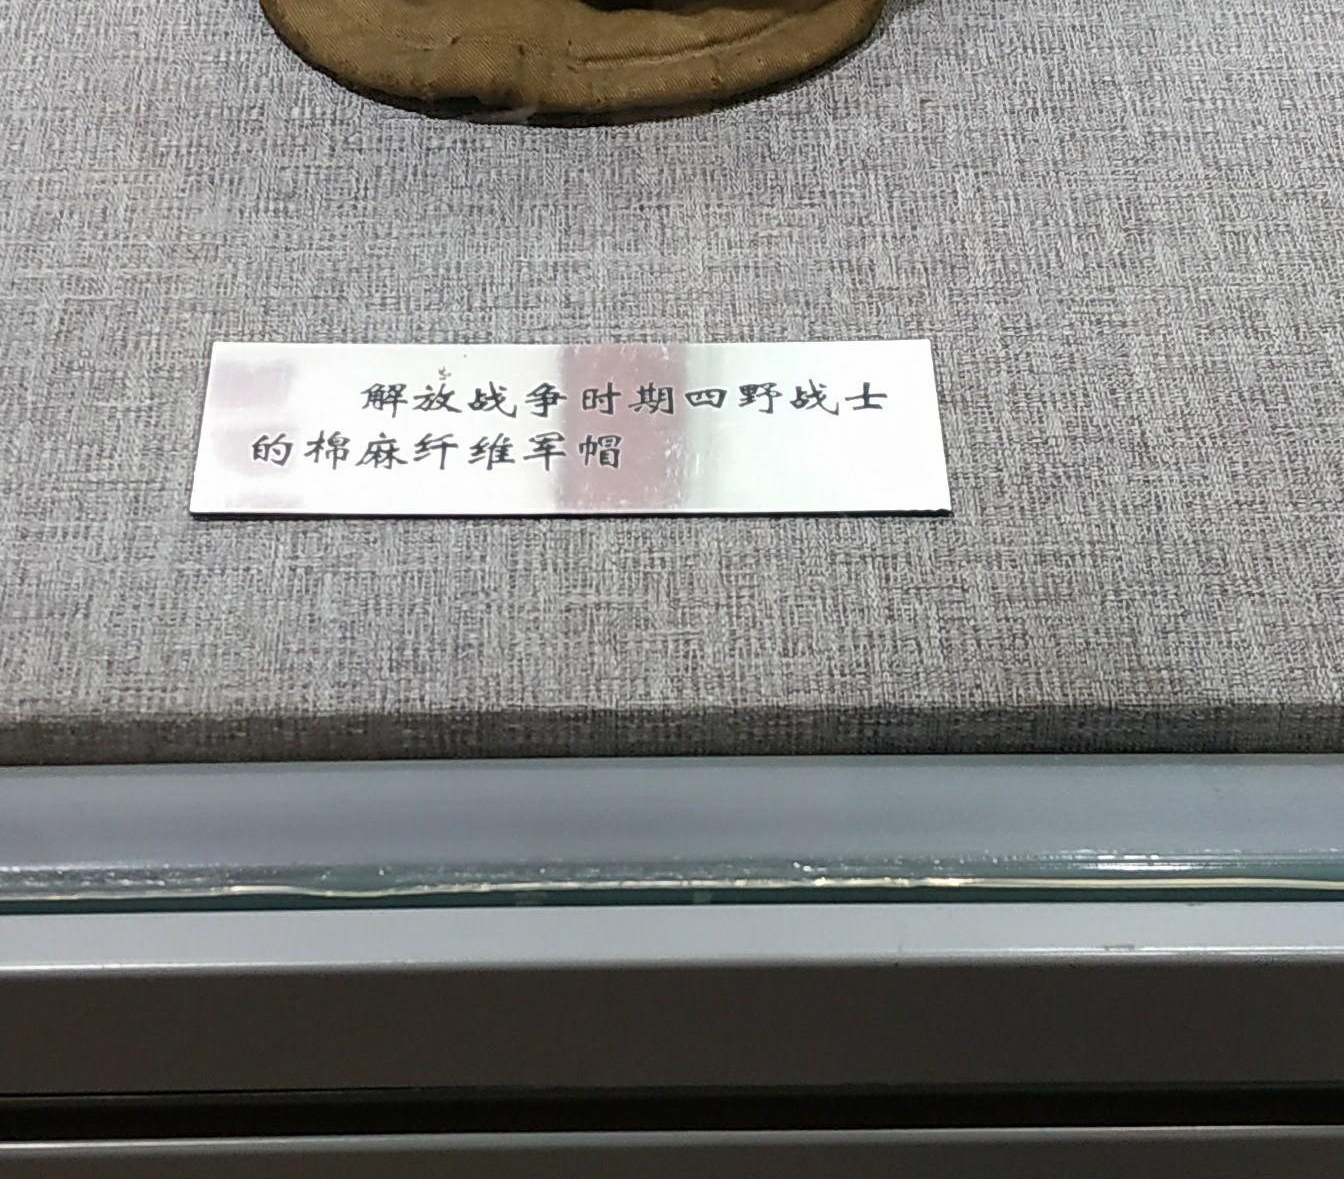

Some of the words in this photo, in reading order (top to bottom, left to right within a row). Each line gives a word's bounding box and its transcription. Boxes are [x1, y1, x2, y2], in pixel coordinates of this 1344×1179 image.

[361, 380, 889, 418] 解放战争时期四野战士
[251, 431, 622, 471] 的棉麻纤维军帽
